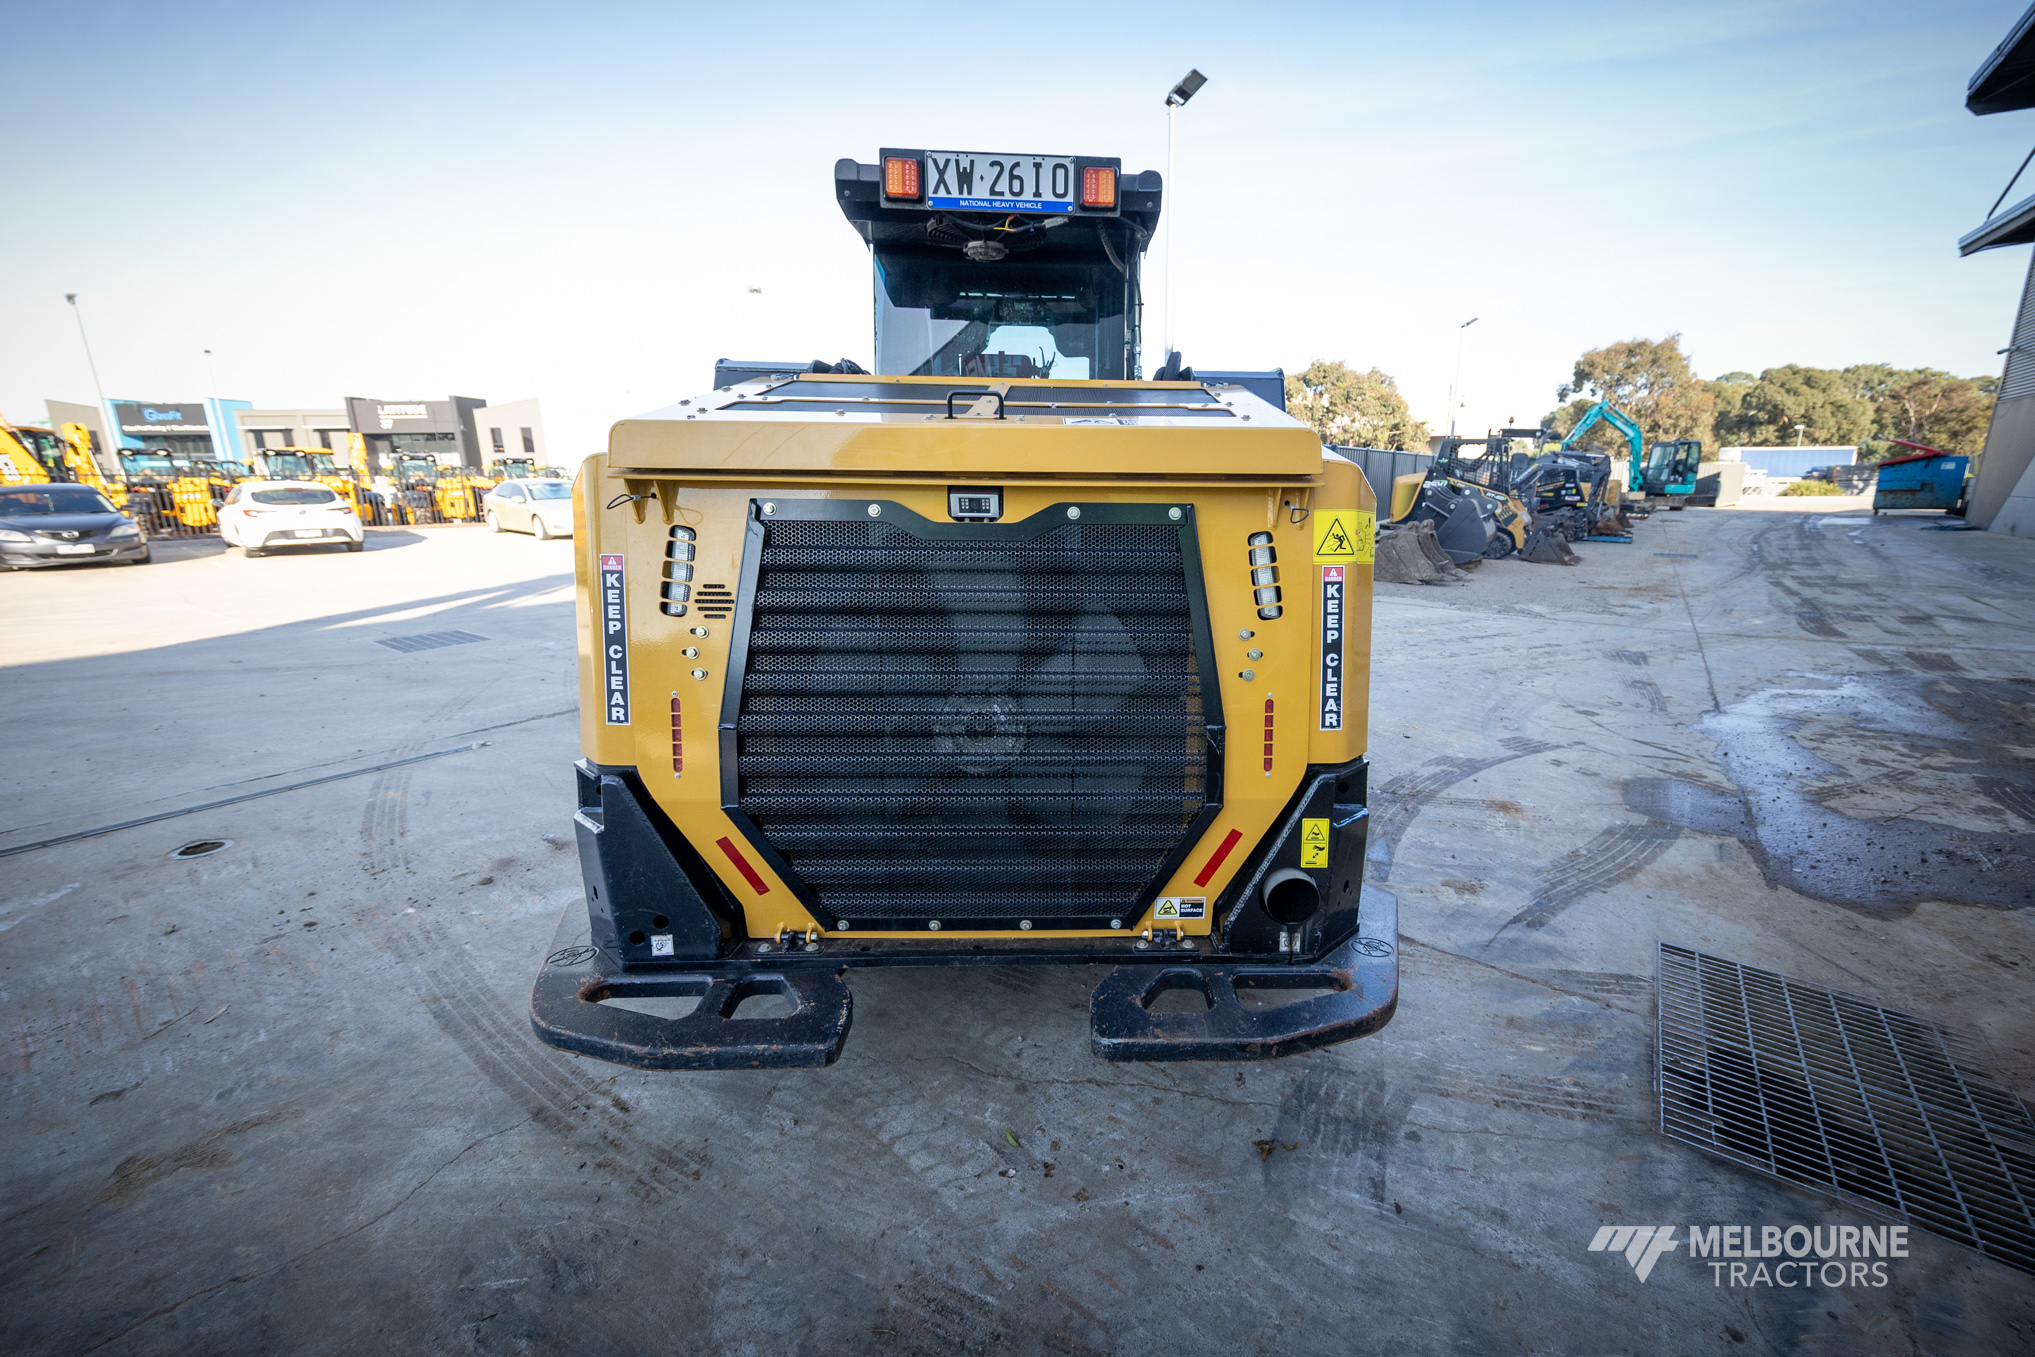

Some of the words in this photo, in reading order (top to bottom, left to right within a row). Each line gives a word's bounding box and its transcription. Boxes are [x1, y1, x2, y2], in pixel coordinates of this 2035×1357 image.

[959, 200, 992, 208] NATIONAL
[992, 200, 1015, 208] HEAVY
[1015, 201, 1043, 210] VEHICLE
[377, 404, 427, 415] LATITUDE
[605, 573, 622, 635] KEEP
[1326, 584, 1341, 644] KEEP
[608, 644, 625, 721] CLEAR
[1324, 653, 1339, 727] CLEAR
